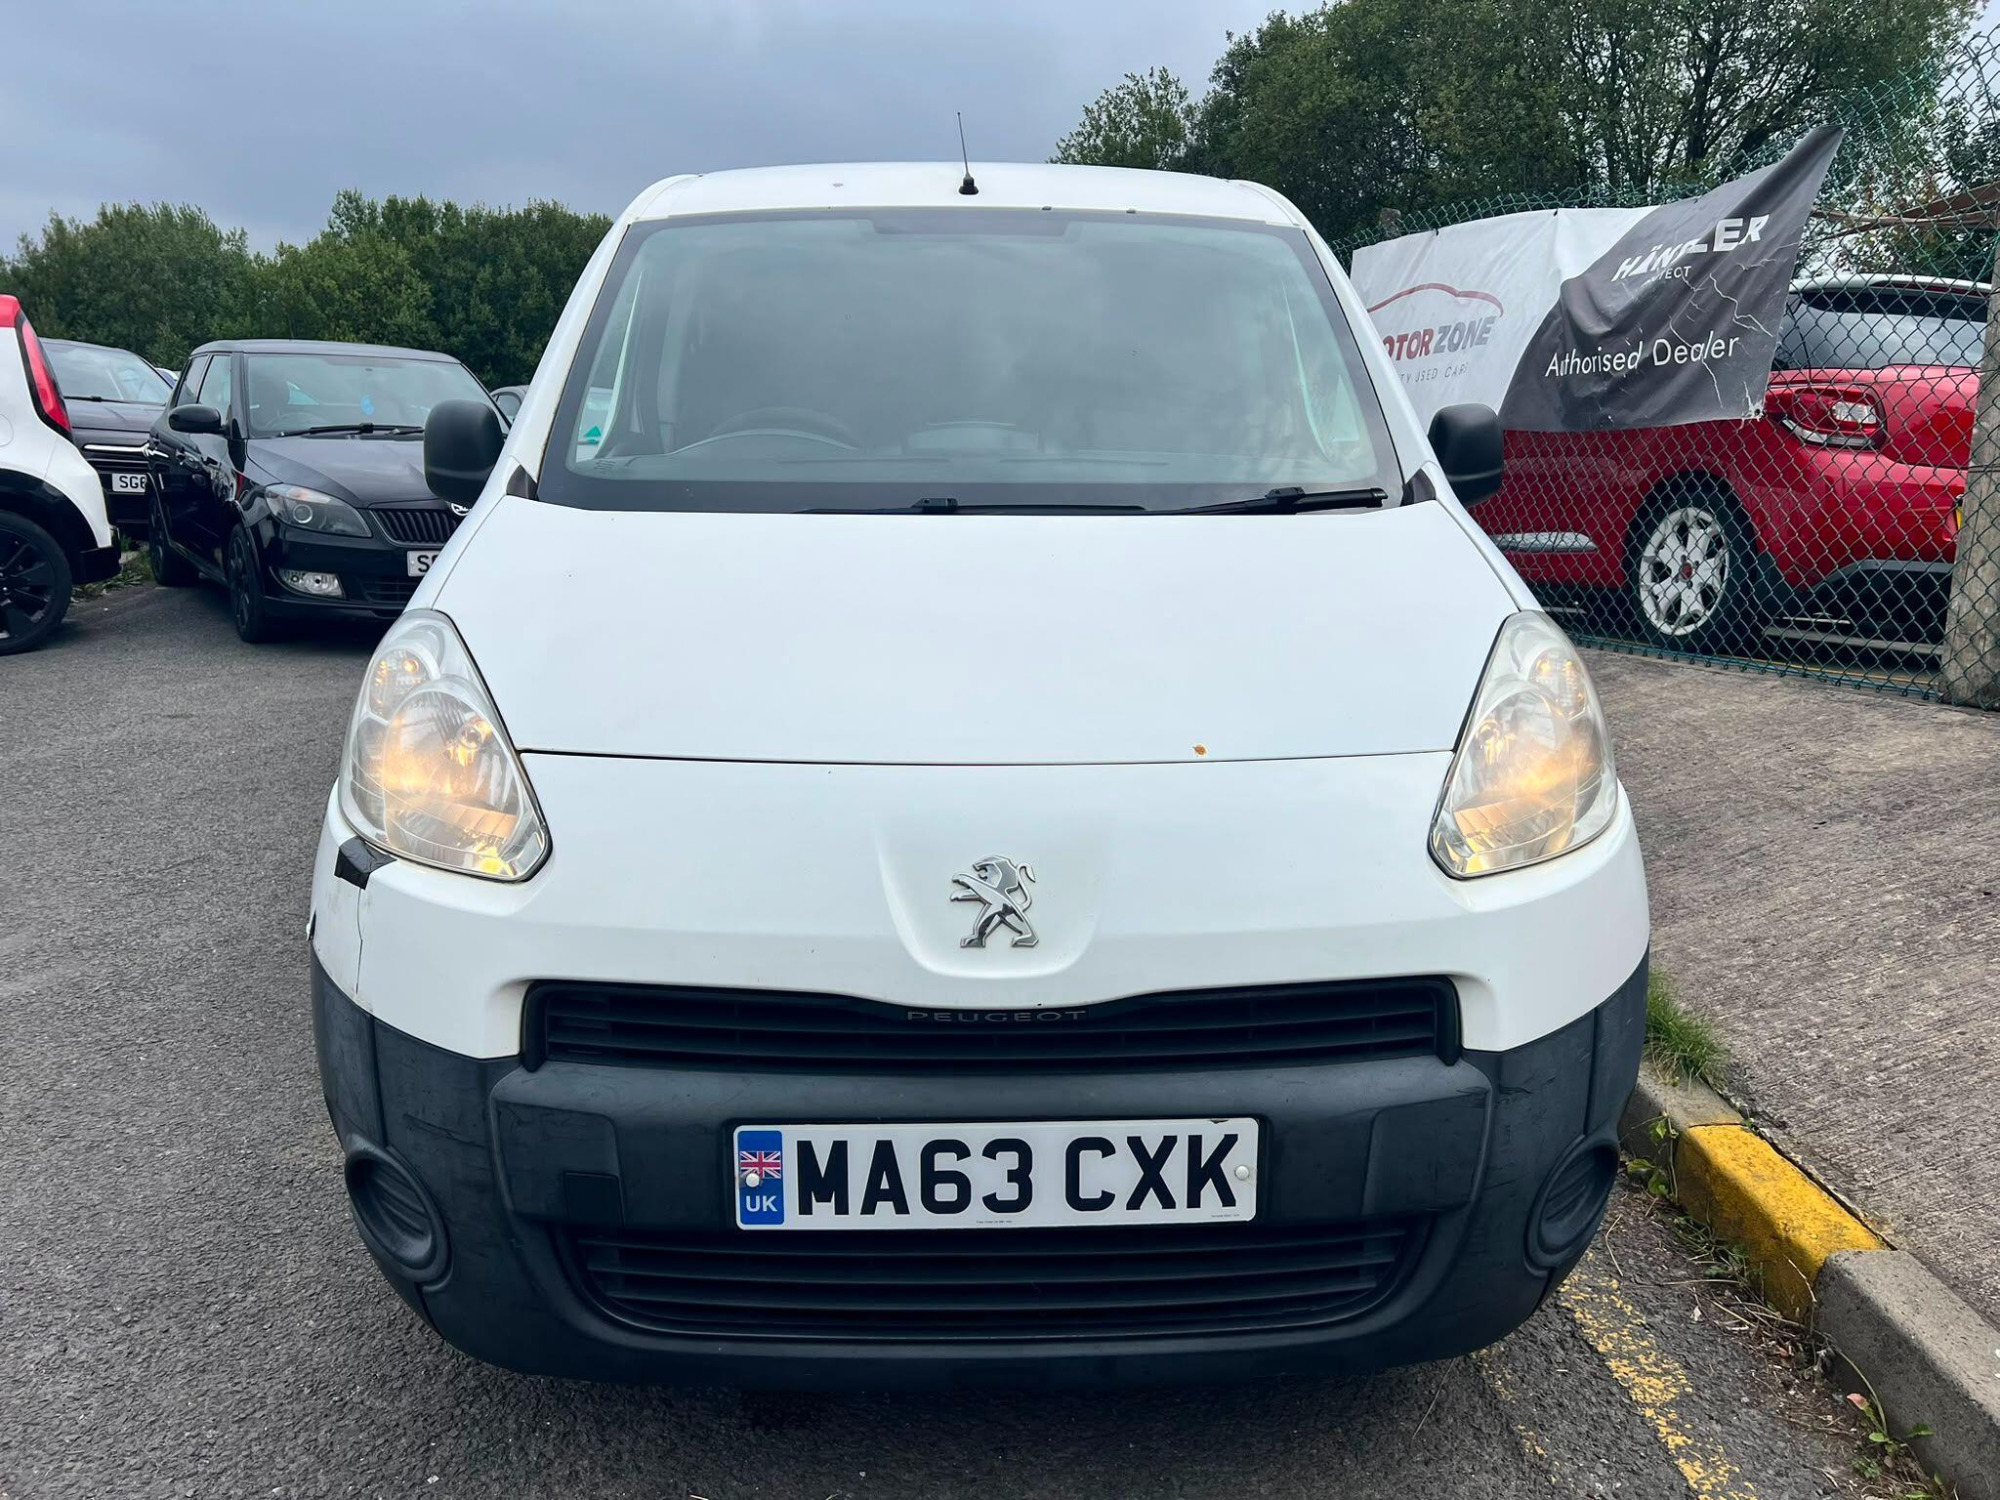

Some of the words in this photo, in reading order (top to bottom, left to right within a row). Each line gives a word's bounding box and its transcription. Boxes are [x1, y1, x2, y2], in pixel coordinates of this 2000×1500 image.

[1382, 316, 1497, 361] OTORZONE
[1652, 330, 1740, 366] Dealer
[907, 1010, 1086, 1022] PEUGEOT
[797, 1137, 1033, 1216] MA63
[1065, 1133, 1239, 1211] CXK
[745, 1195, 778, 1213] UK
